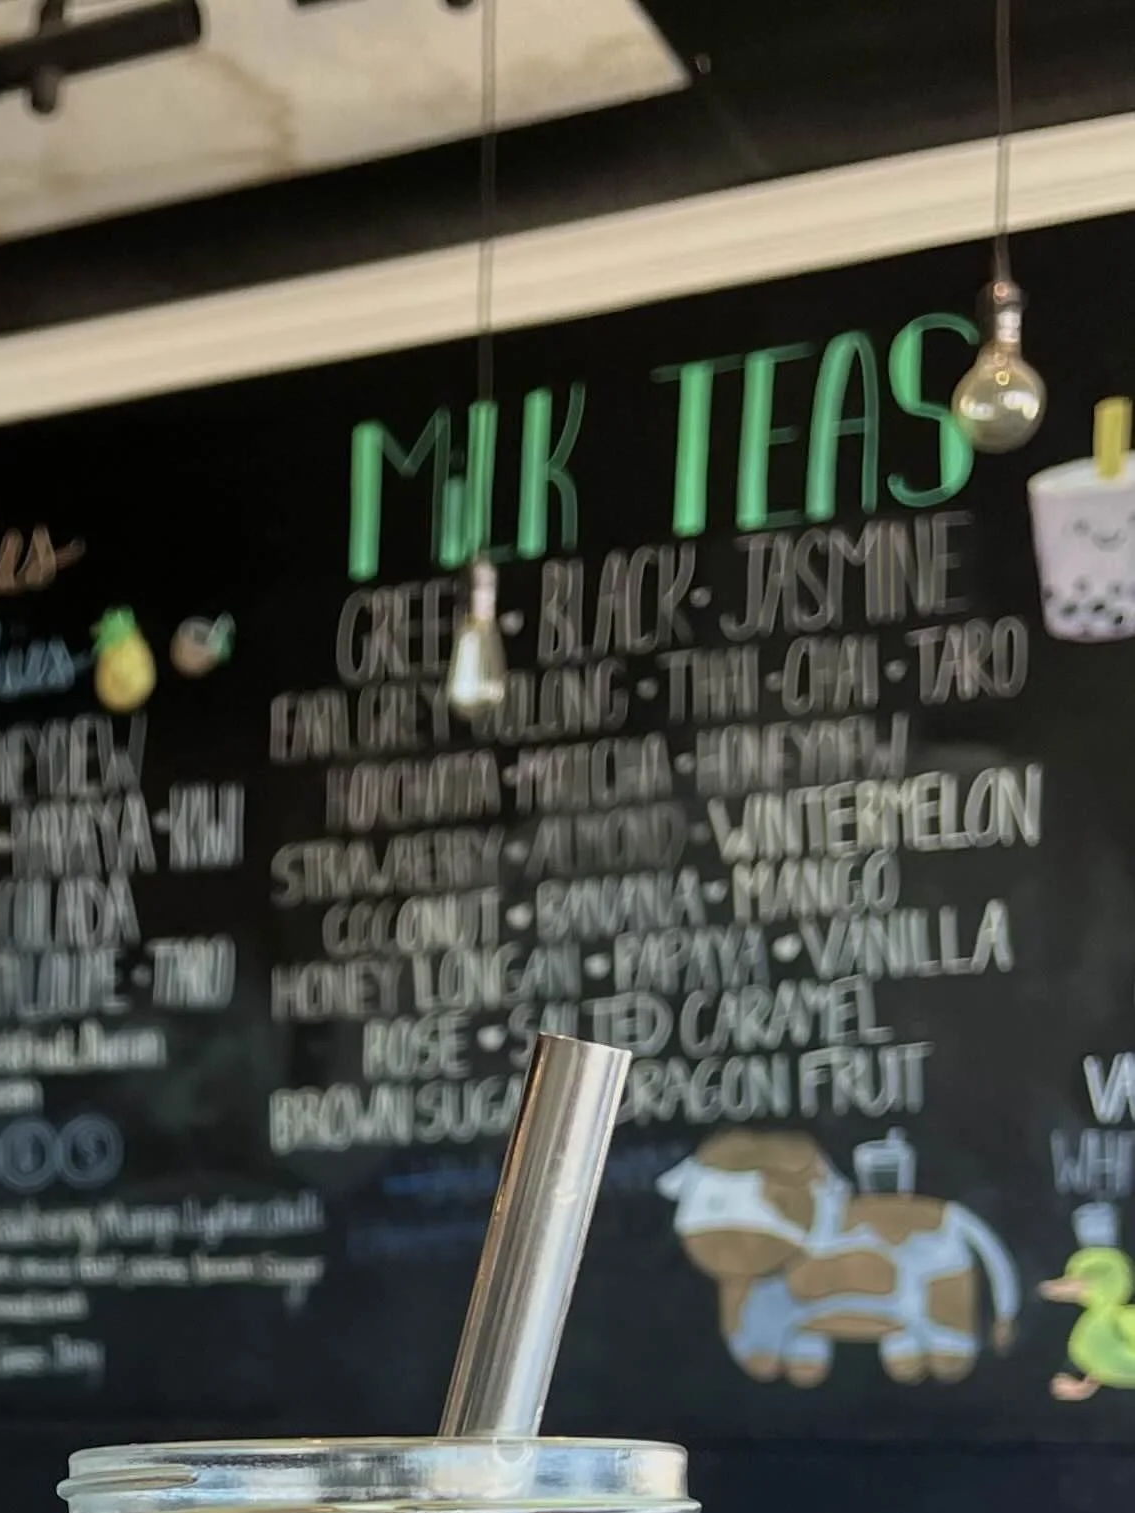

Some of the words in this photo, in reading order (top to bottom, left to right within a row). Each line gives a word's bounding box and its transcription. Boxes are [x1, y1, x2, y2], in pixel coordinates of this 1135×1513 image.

[347, 381, 587, 582] MILK
[650, 312, 980, 539] TEAS
[337, 578, 471, 685] GREE
[536, 542, 698, 665] BLACK
[720, 510, 974, 642] JASMINE
[357, 676, 452, 754] GREY
[660, 645, 762, 723] THAI
[782, 633, 881, 717] CHAI
[905, 617, 1029, 706] TARO
[515, 731, 673, 815] MATCHA
[695, 710, 909, 797] HONEYDEW
[707, 762, 1043, 865] WINTERMELON
[321, 886, 504, 956] COCONUT
[534, 862, 707, 944] BANANA
[731, 848, 902, 926] MANGO
[270, 955, 406, 1024] HONEY
[411, 940, 583, 1014] LONGAN
[613, 923, 769, 996] PAPAYA
[801, 898, 1015, 982] VANILLA
[362, 1006, 473, 1081] ROSE
[680, 973, 894, 1056] CARAMEL
[268, 1082, 413, 1156] BROWN
[415, 1068, 525, 1147] SUGA
[799, 1041, 934, 1120] FRUIT
